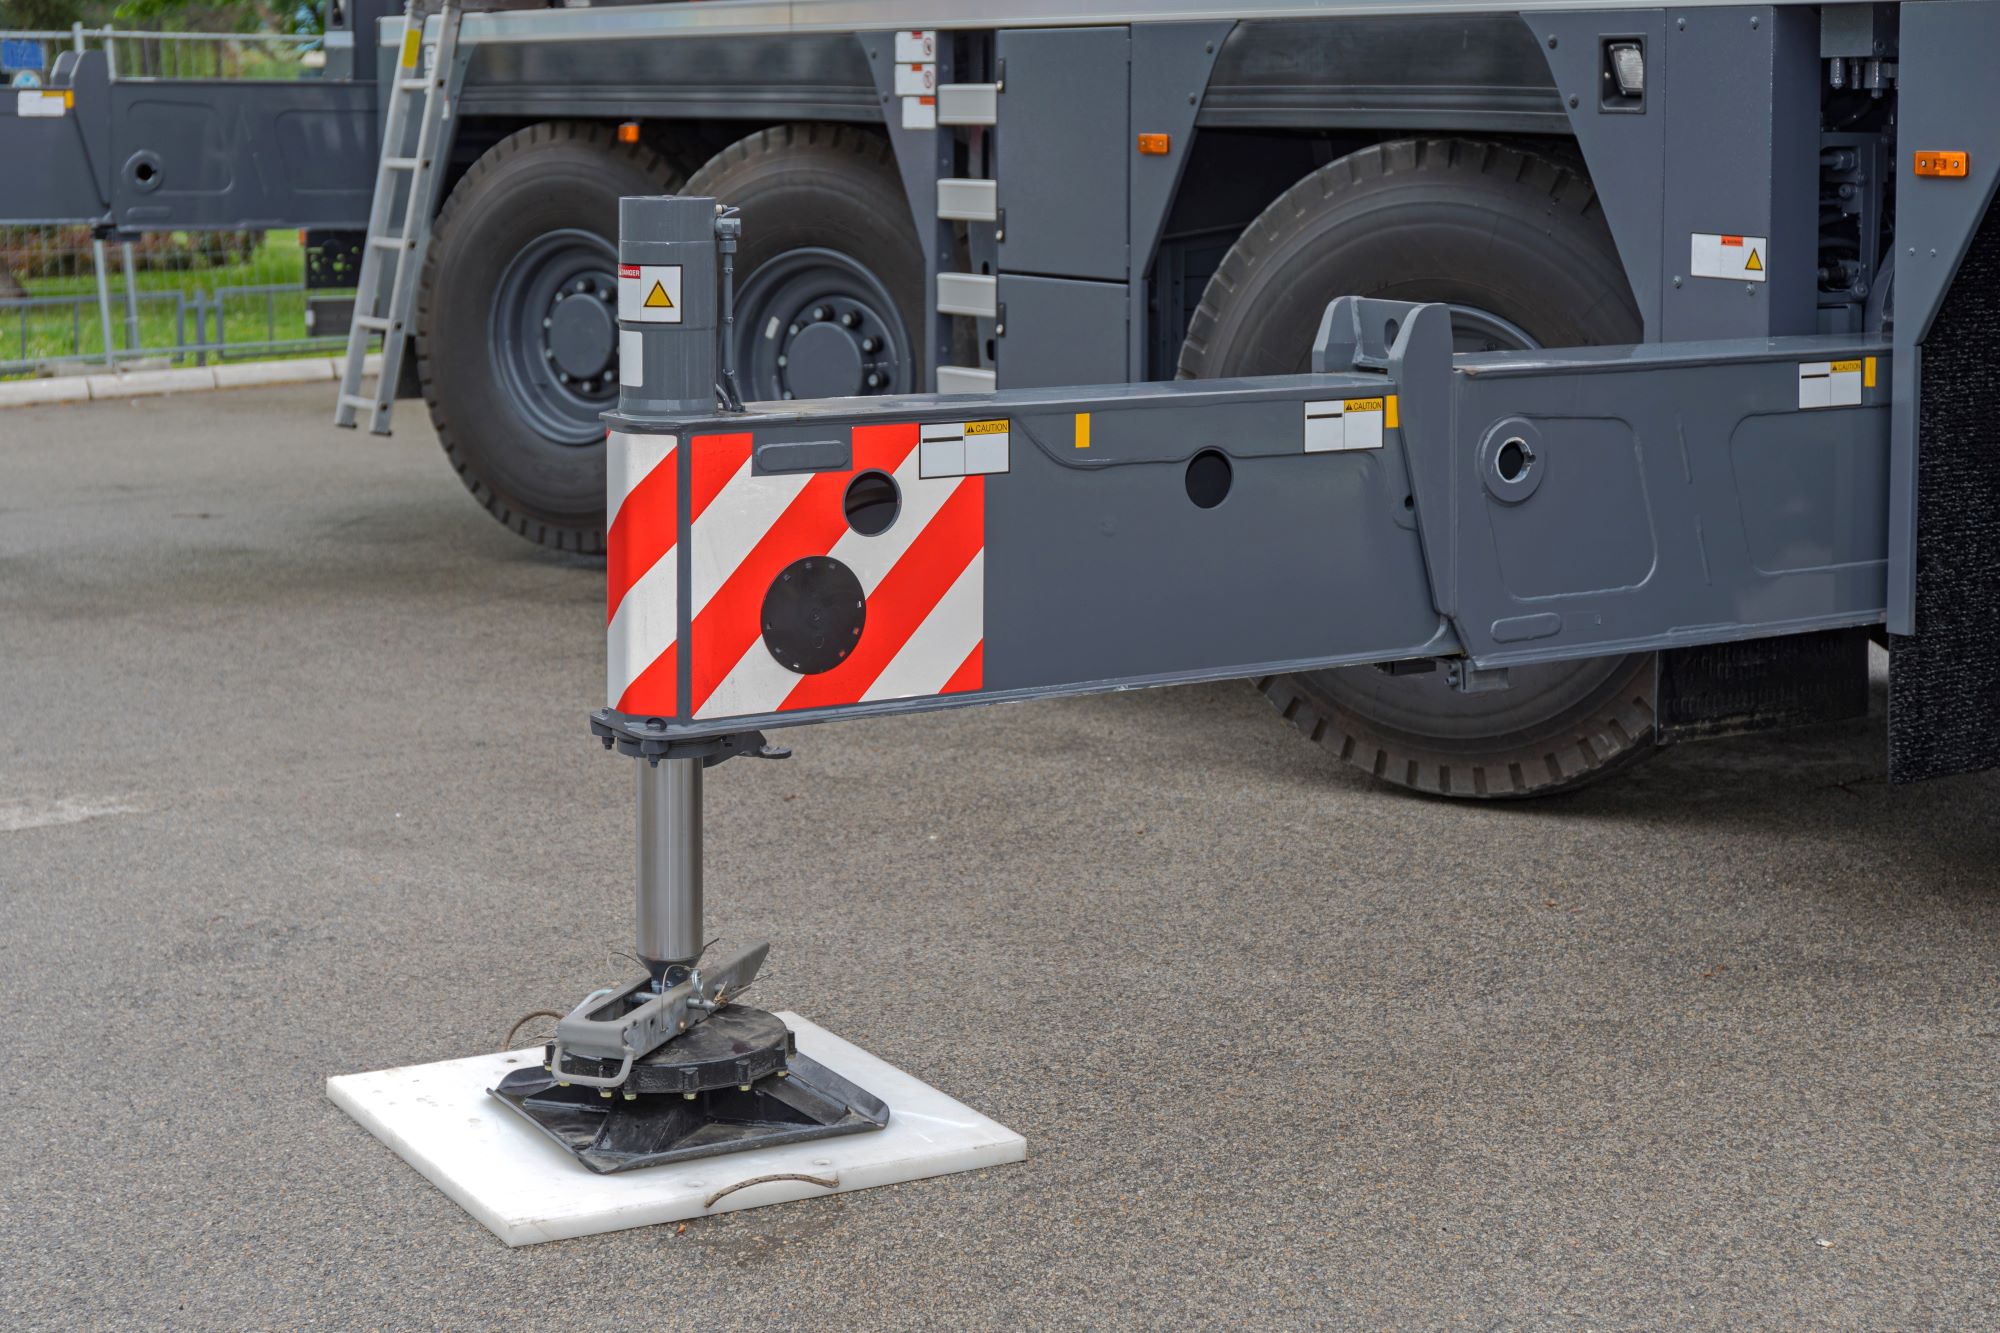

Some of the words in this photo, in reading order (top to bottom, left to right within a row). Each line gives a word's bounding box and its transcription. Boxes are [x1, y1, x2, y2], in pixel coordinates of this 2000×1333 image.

[1837, 362, 1861, 371] CAUTION
[1353, 401, 1382, 411] CAUTION
[975, 423, 1008, 433] CAUTION
